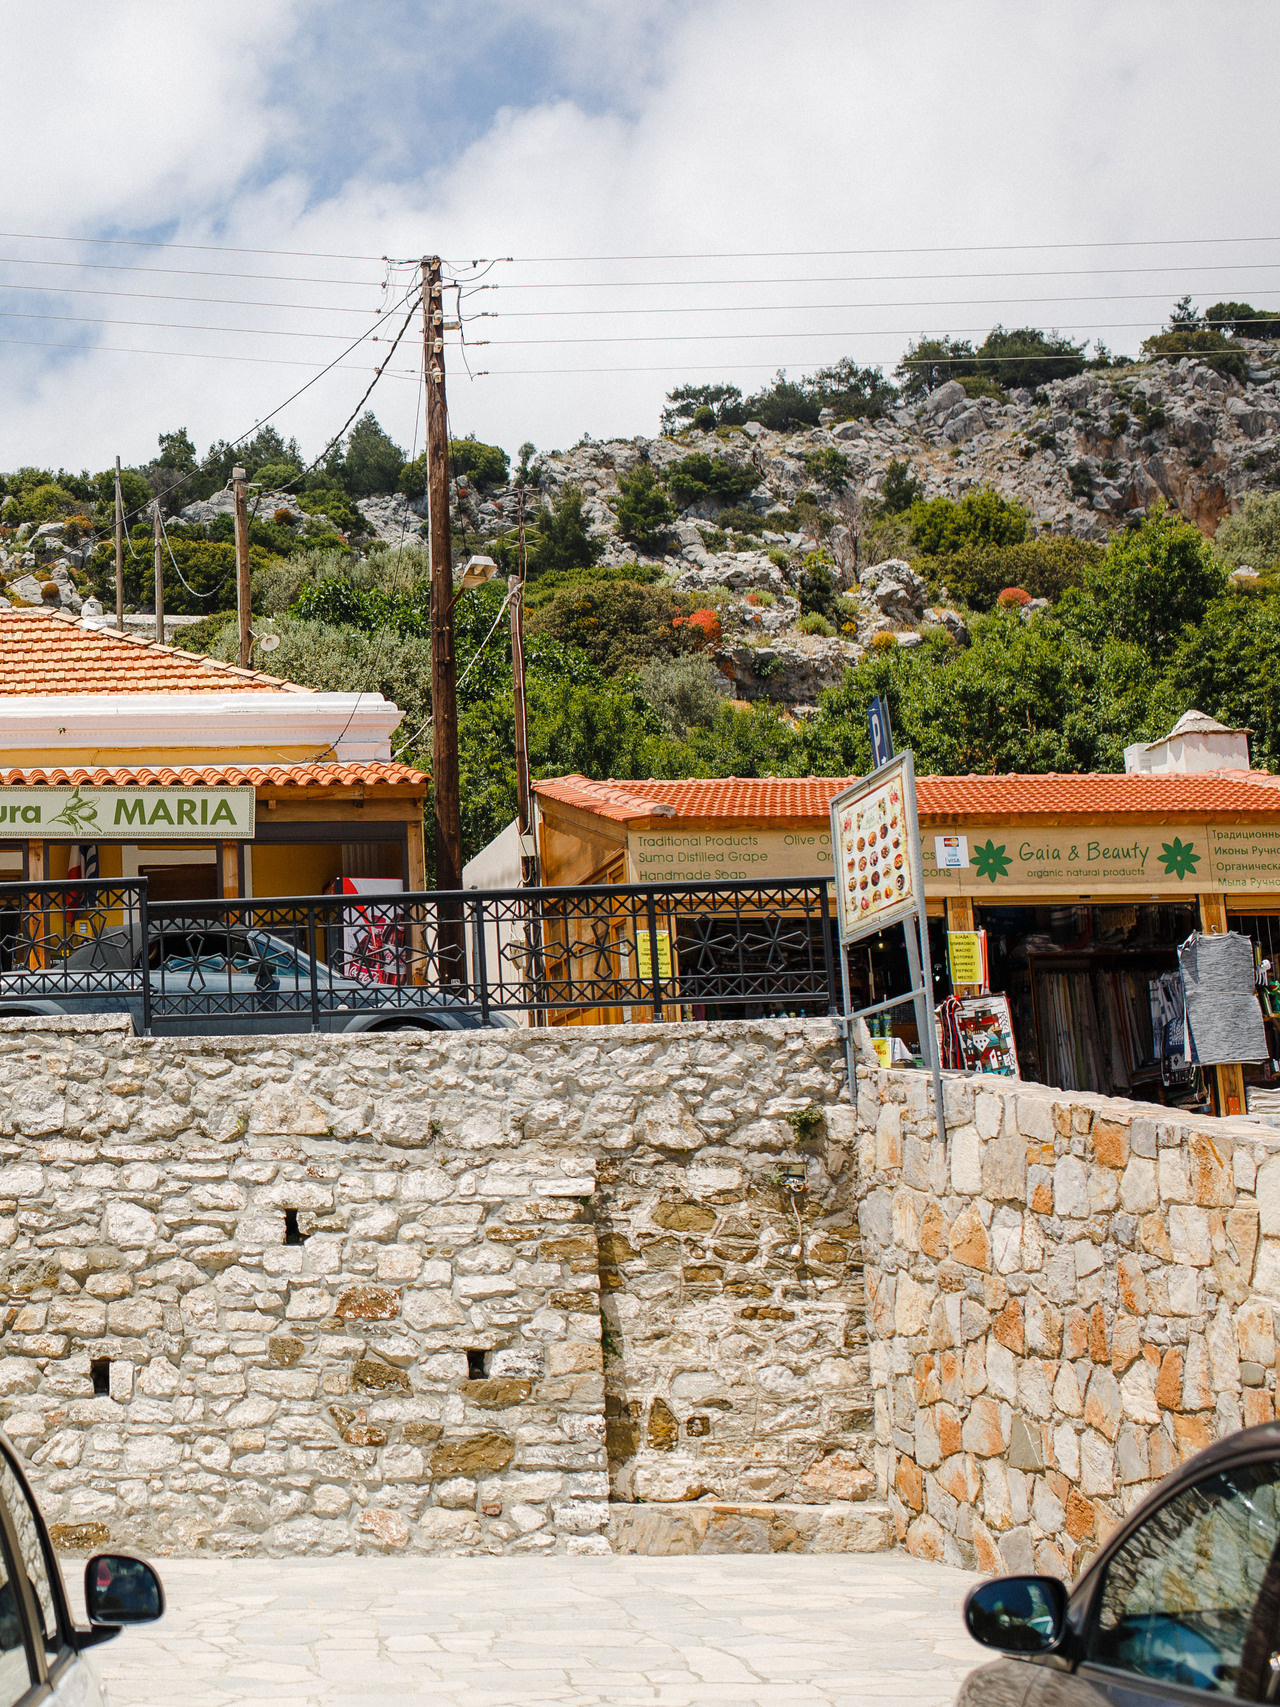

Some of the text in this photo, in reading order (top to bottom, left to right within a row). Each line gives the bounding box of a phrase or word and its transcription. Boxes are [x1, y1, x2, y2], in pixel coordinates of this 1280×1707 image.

[113, 798, 238, 825] MARIA
[638, 835, 759, 846] Traditional Products
[783, 834, 816, 846] Olive
[1019, 841, 1150, 867] Gaia & Beauty
[1214, 846, 1249, 855] Иконы
[638, 852, 768, 865] Suma Distilled Grape
[639, 869, 747, 881] Handmade Soap
[1027, 868, 1145, 879] organic natural products
[1218, 878, 1247, 886] Мыла
